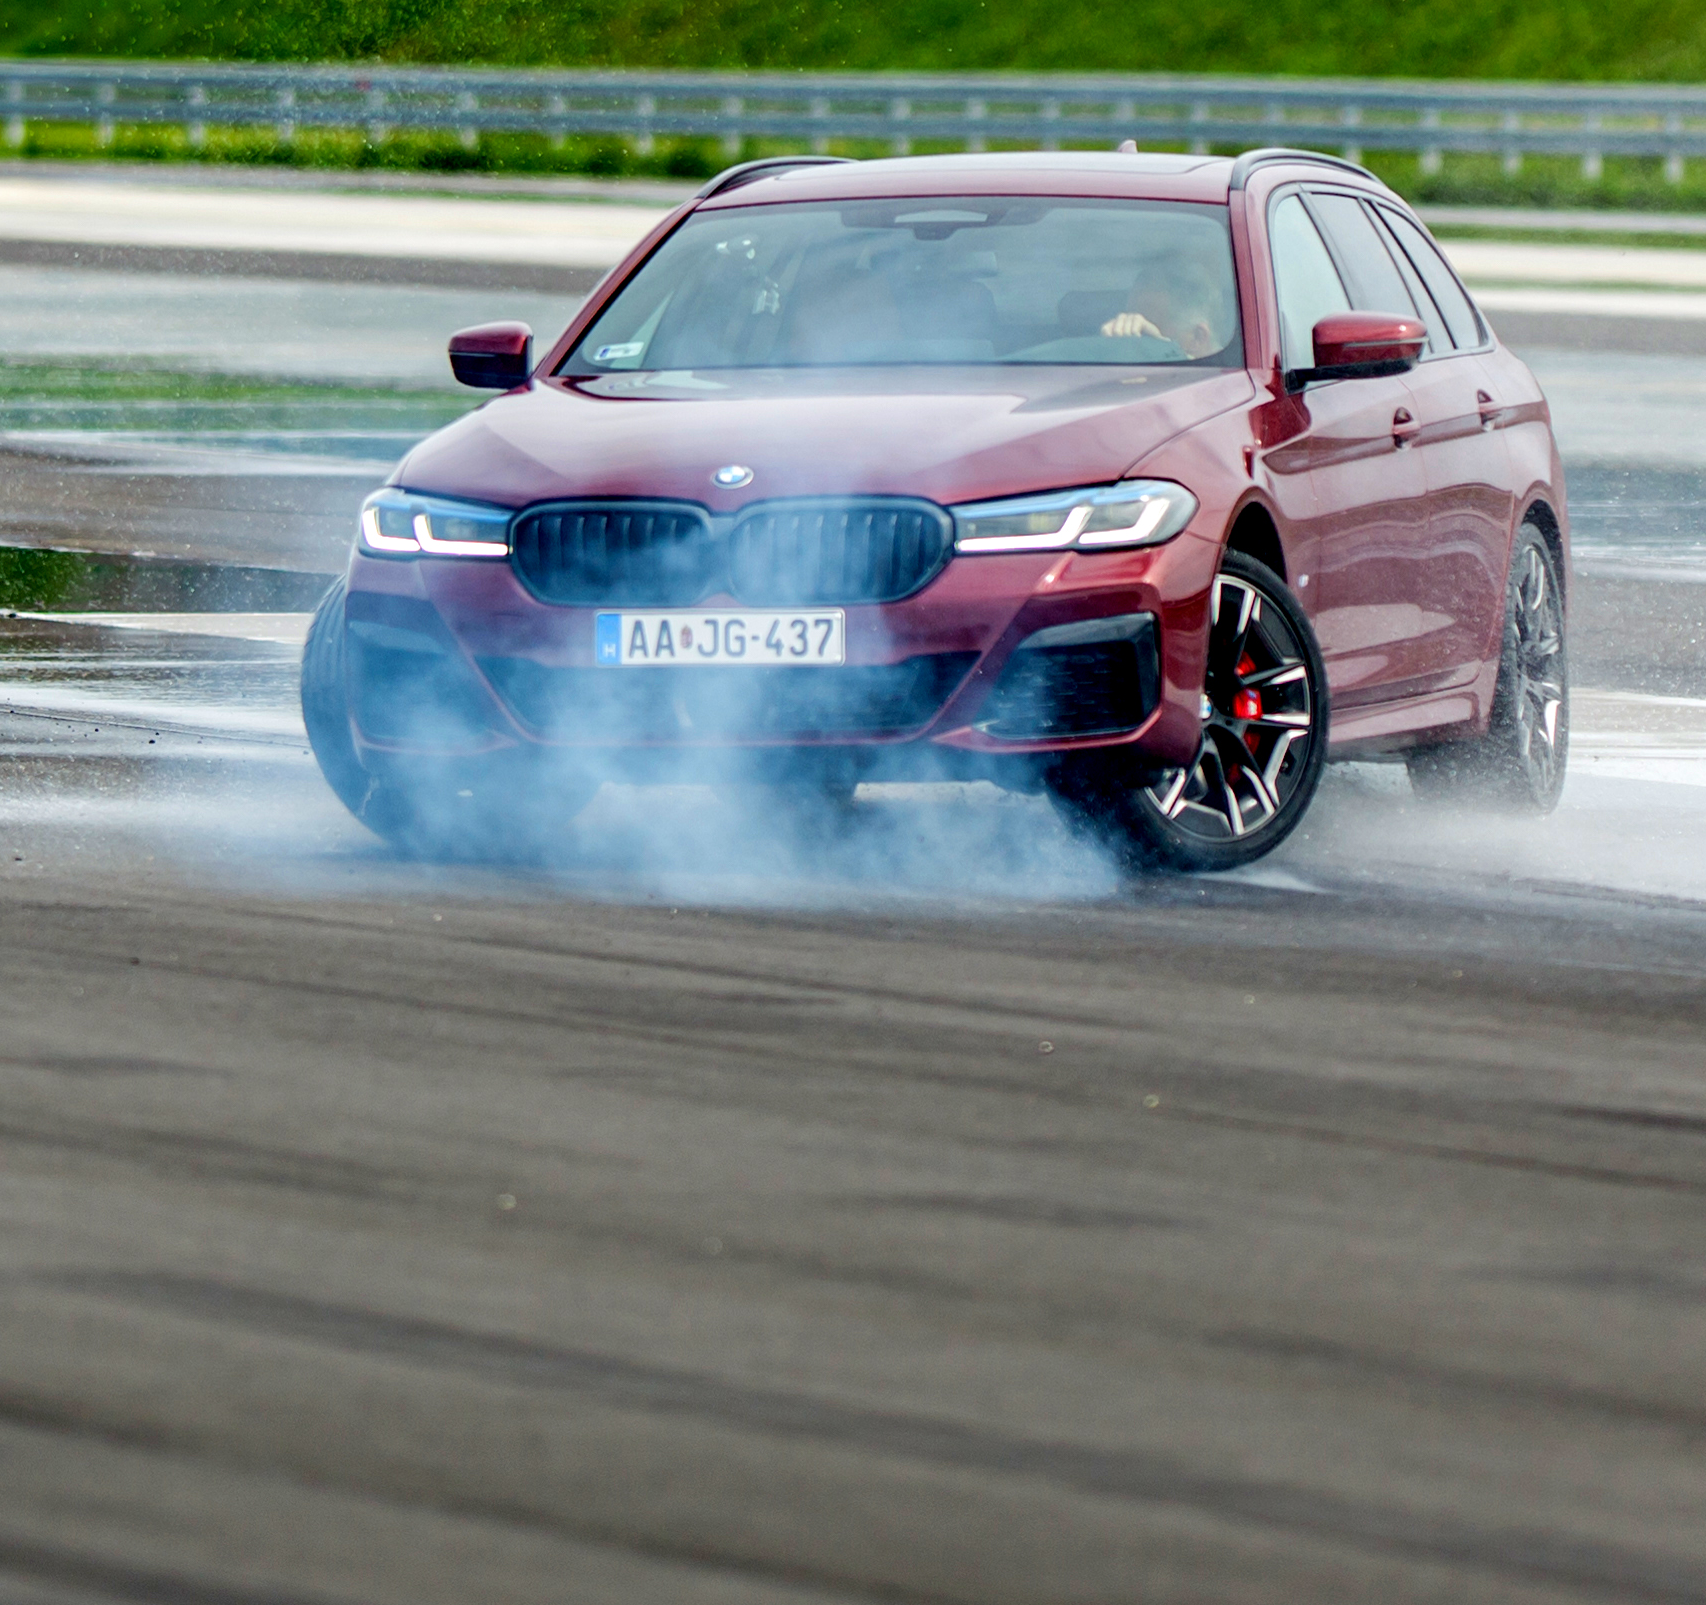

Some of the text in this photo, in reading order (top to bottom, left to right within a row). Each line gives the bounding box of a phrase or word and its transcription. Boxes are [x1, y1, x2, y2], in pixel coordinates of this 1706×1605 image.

[603, 643, 616, 658] H
[628, 618, 834, 659] AA JG-437
